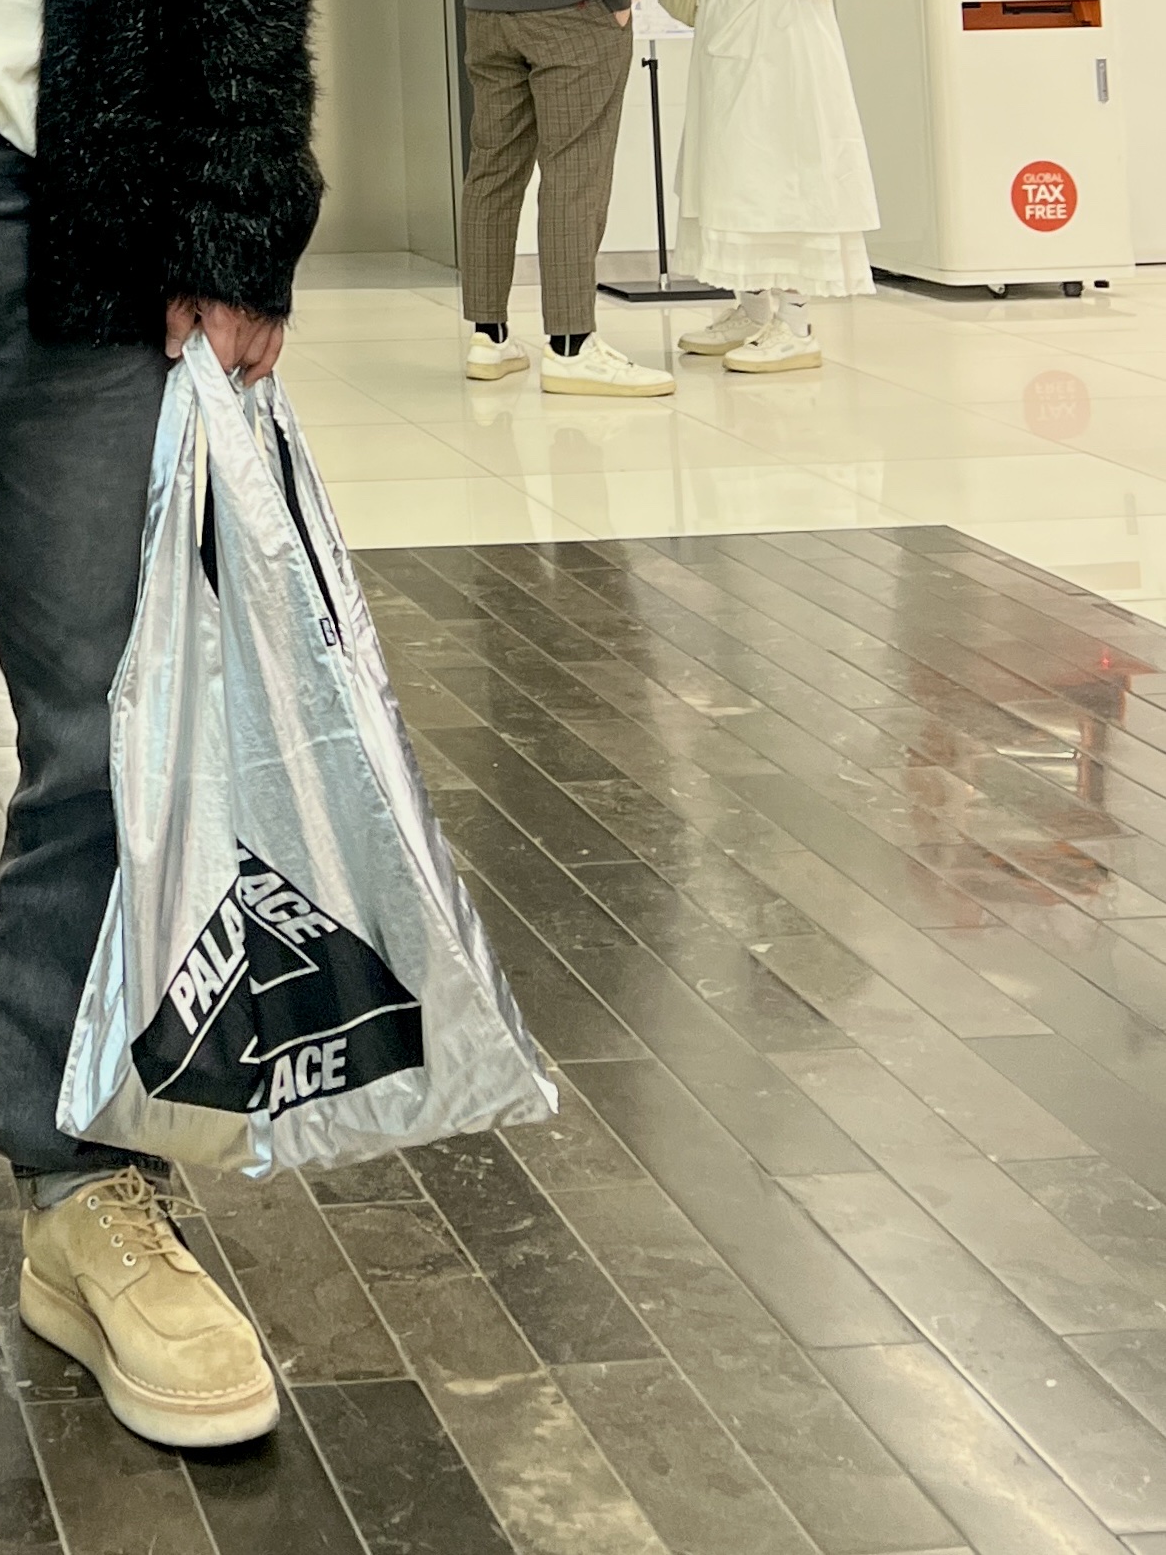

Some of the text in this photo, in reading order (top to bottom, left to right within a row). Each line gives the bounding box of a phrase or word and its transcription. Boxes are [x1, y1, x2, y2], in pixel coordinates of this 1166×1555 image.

[1023, 172, 1064, 184] GLOBAL
[1022, 184, 1066, 204] TAX
[1025, 203, 1068, 220] FREE
